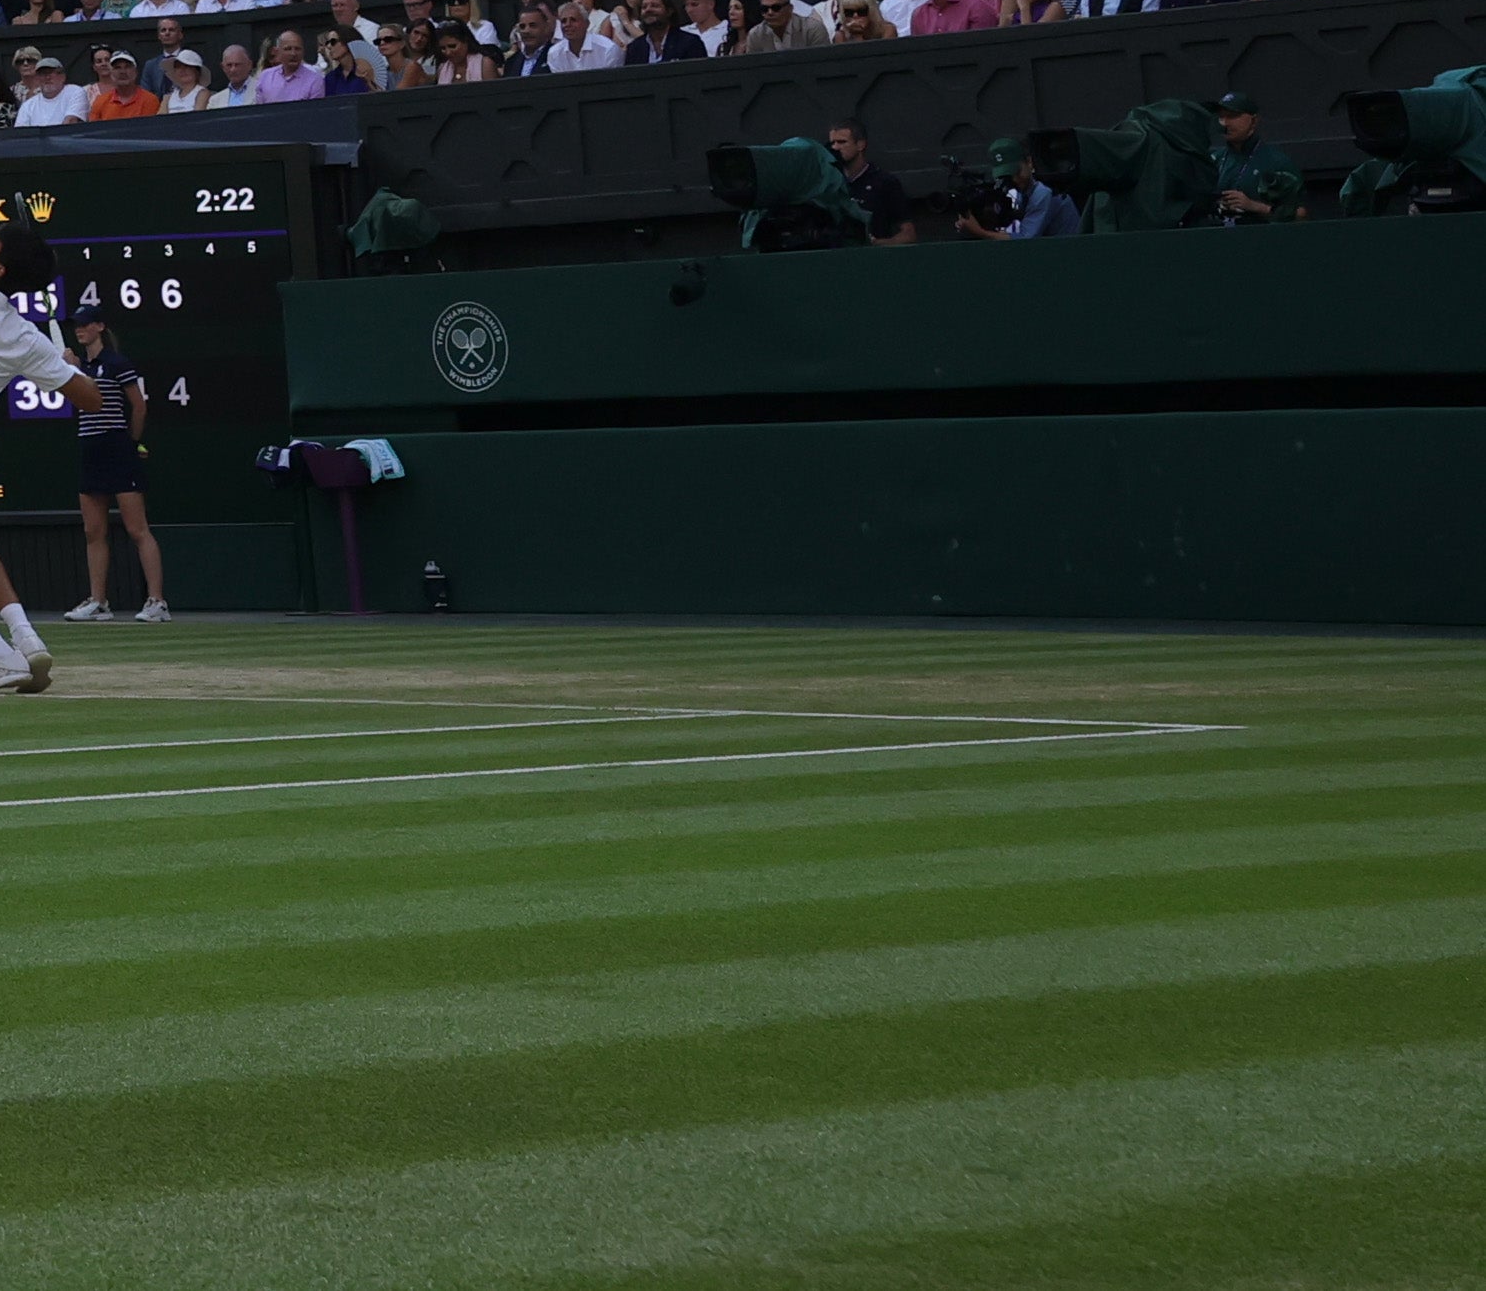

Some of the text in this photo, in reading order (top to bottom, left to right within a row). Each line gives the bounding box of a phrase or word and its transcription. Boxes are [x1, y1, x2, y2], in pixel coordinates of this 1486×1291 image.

[195, 187, 255, 213] 2:22
[83, 241, 257, 260] 1 2 3 4 5
[79, 281, 101, 306] 4
[120, 278, 141, 309] 6
[161, 278, 182, 309] 6
[436, 306, 503, 346] THE CHAMPIONSHIPS
[448, 366, 499, 387] WIMBLEDON
[168, 376, 190, 406] 4
